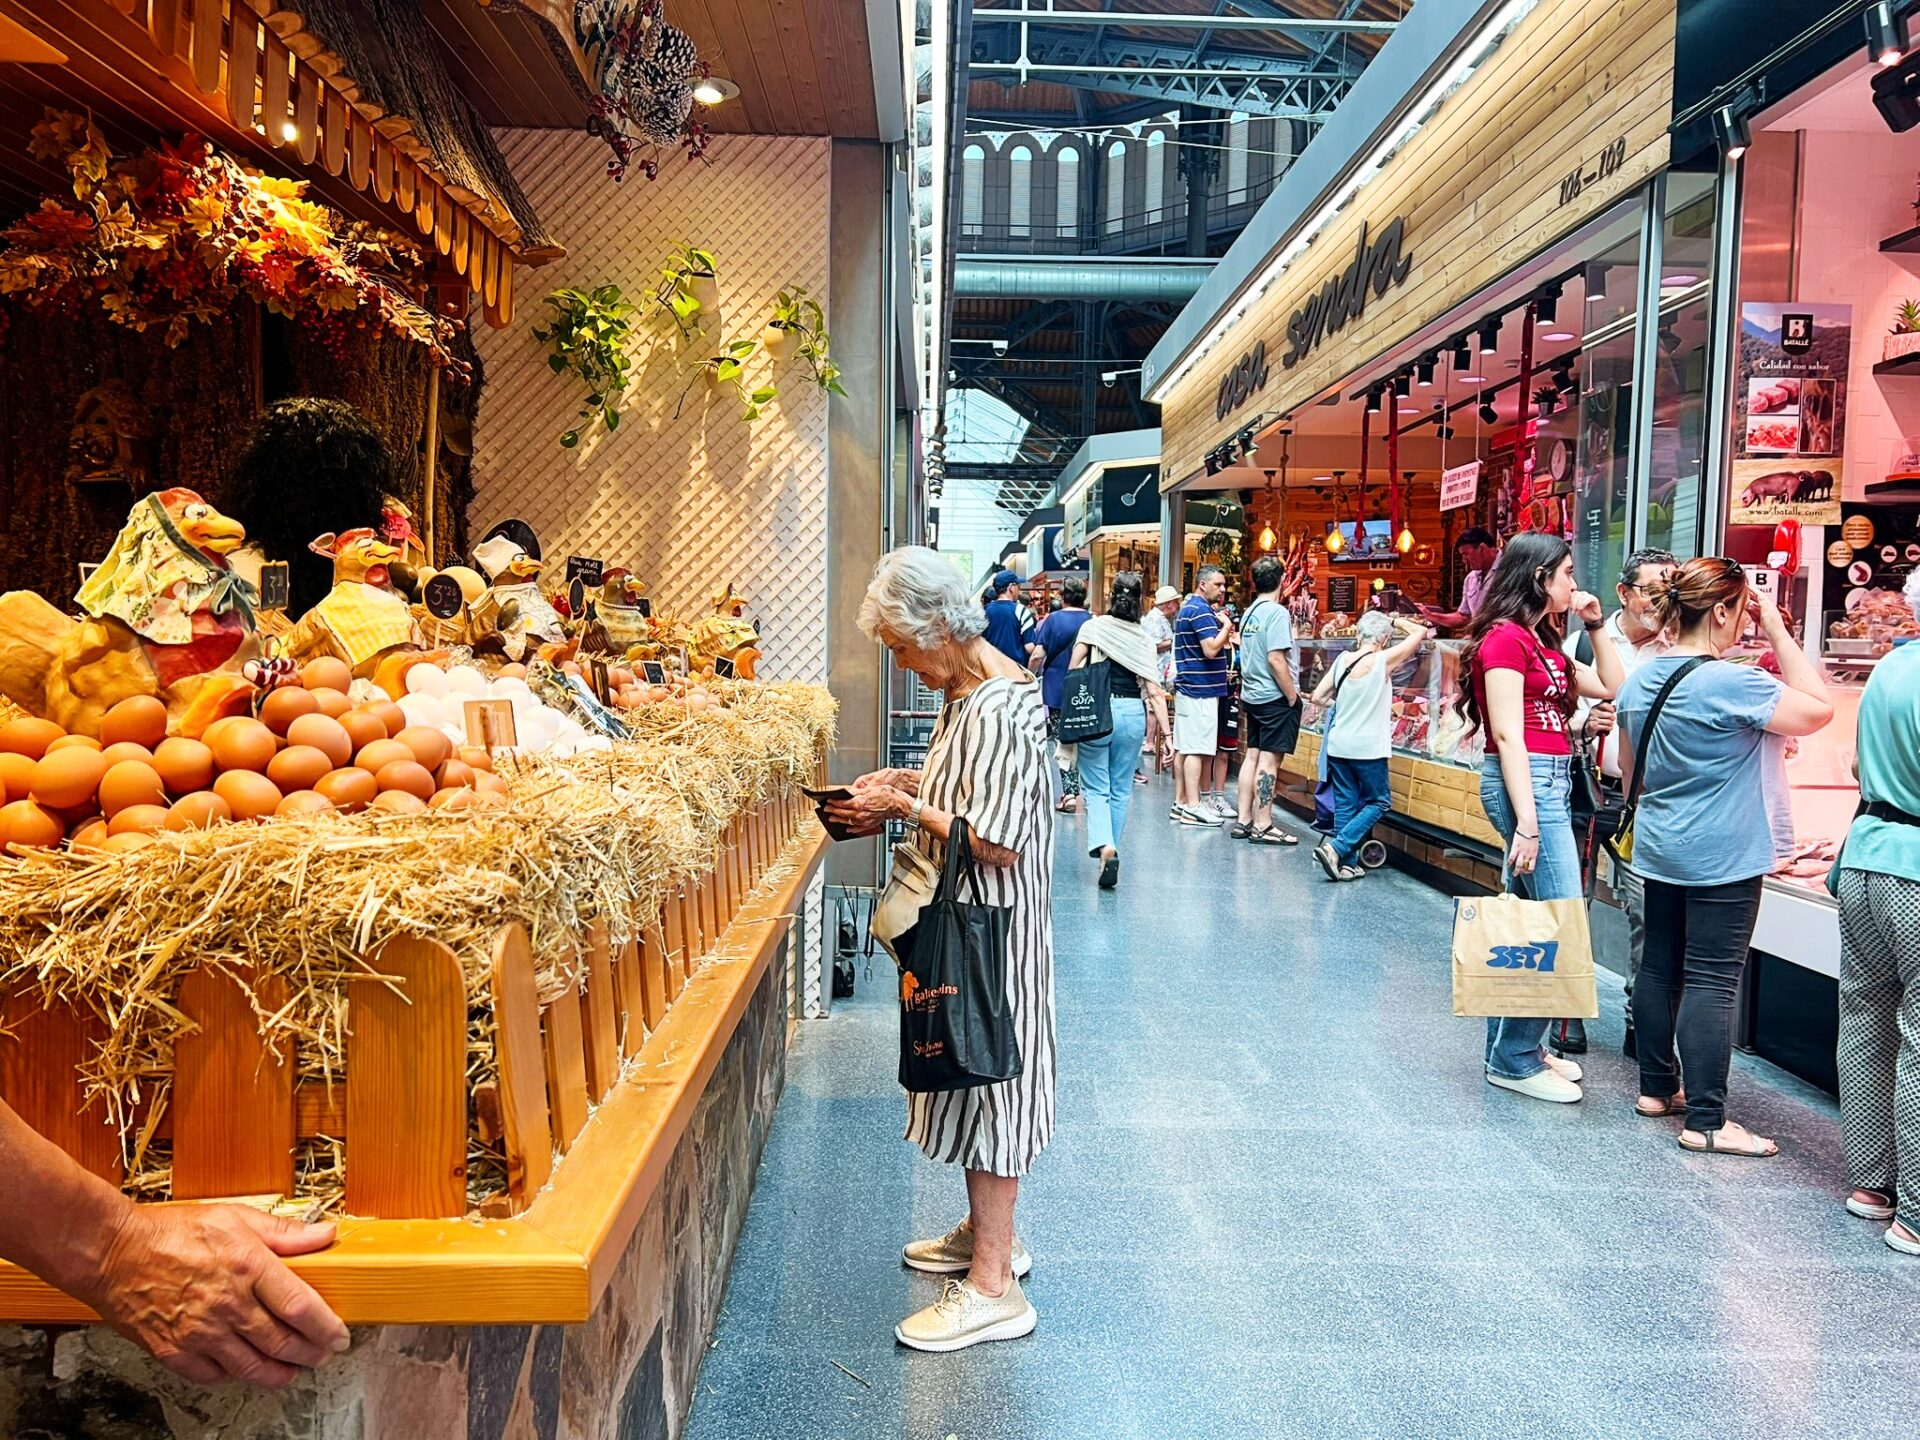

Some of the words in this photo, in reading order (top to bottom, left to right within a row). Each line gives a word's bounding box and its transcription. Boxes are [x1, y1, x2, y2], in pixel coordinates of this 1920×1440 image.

[1216, 338, 1270, 422] casa
[1282, 214, 1413, 369] sendra
[1759, 359, 1791, 370] Calidad
[1808, 360, 1830, 370] sabor
[1748, 505, 1823, 516] www.batalle.com
[1755, 573, 1768, 585] B
[1071, 694, 1095, 706] GOYA
